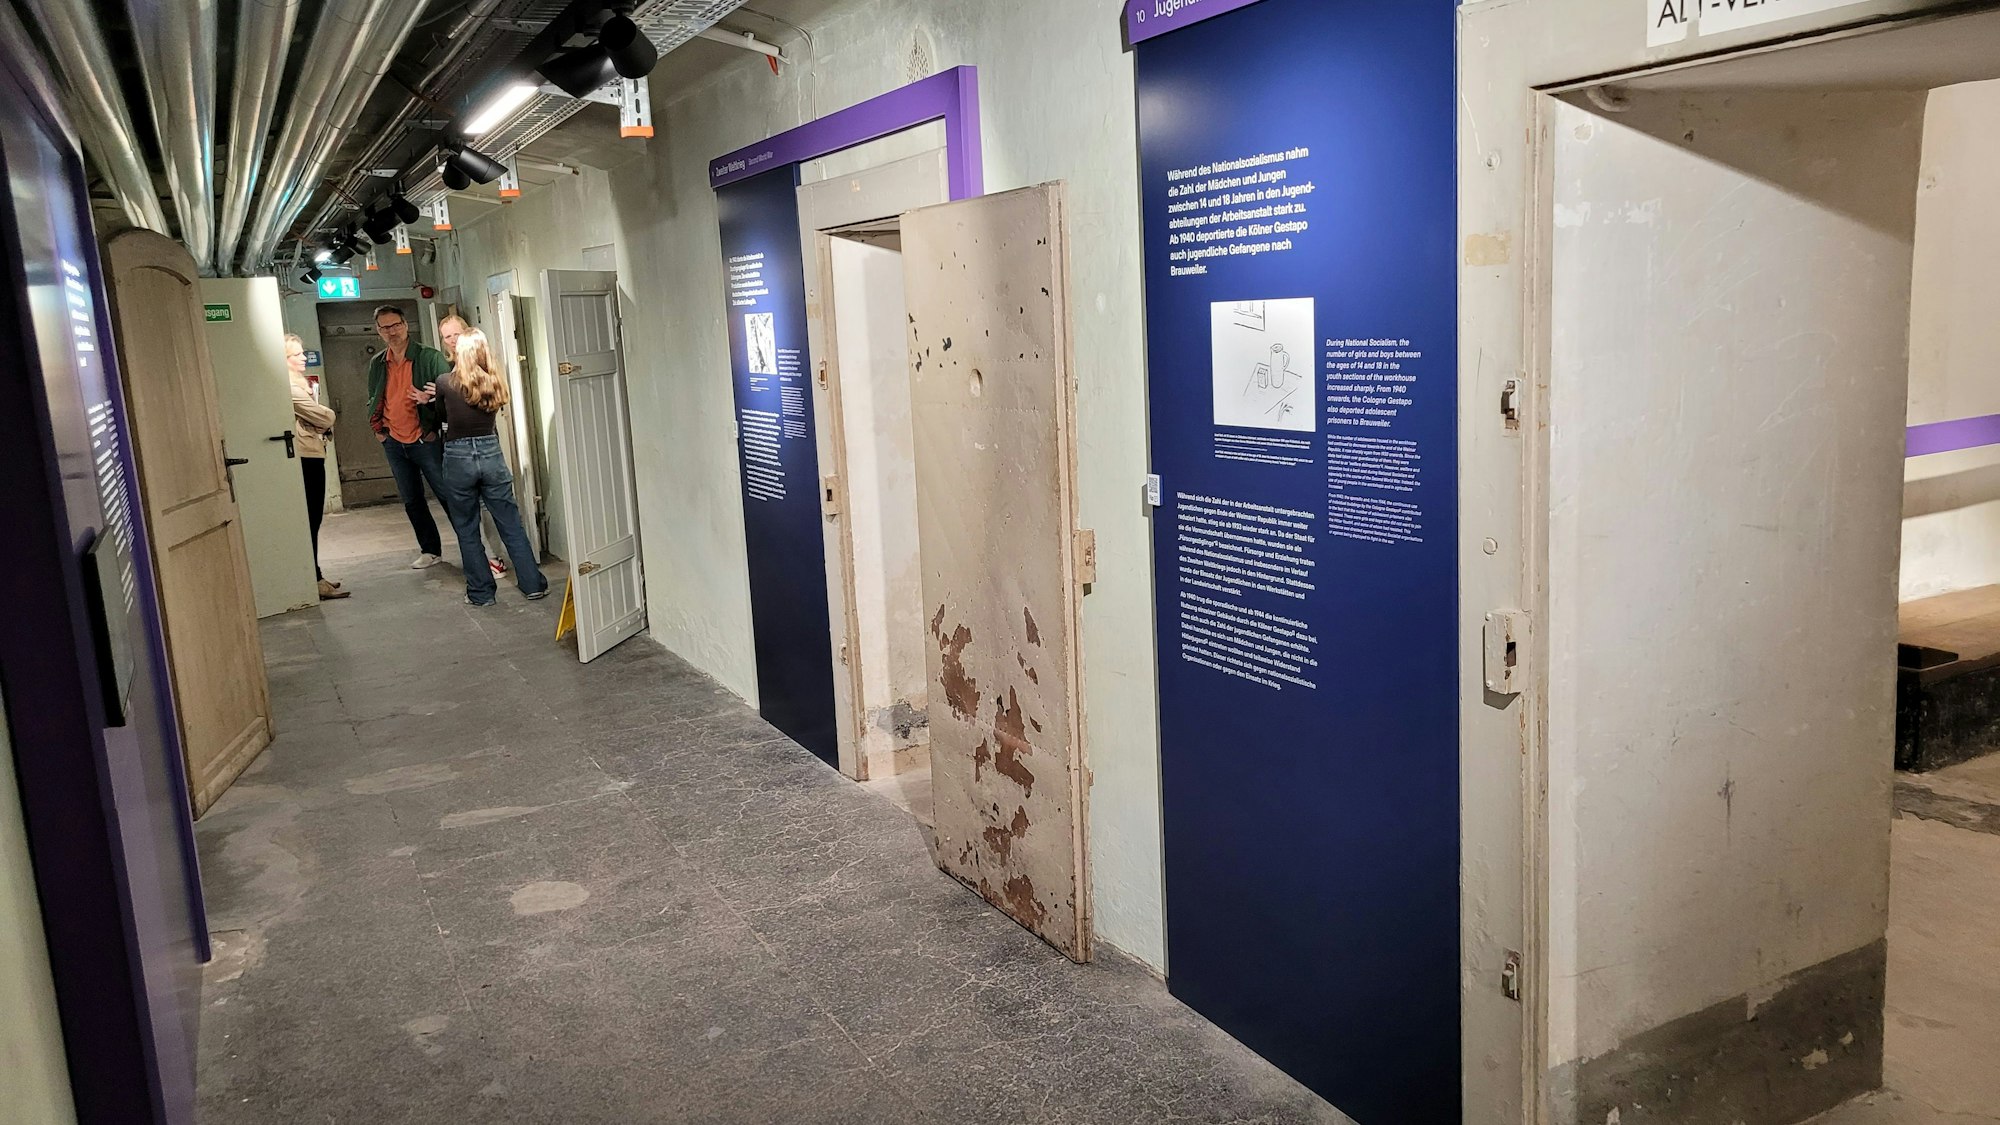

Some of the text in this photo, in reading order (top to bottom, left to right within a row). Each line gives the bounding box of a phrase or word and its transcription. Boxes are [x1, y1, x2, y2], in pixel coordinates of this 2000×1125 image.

[1136, 10, 1146, 23] 10
[1167, 147, 1308, 181] Während des Nationalsozialismus nahm
[1168, 169, 1286, 197] die Zahl der Mädchen und Jungen
[1168, 181, 1315, 213] zwischen 14 und 18 Jahren in den Jugend-
[1169, 203, 1306, 229] abteilungen der Arbeitsanstalt stark zu.
[1169, 220, 1307, 245] Ab 1940 deportierte die Kölner Gestapo
[1170, 239, 1291, 261] auch jugendliche Gefangene nach
[1171, 264, 1207, 276] Brauweiler.
[206, 309, 230, 318] sgang
[1326, 339, 1344, 348] During
[1369, 339, 1398, 347] Socialism,
[1355, 351, 1367, 359] girls
[1380, 351, 1394, 359] boys
[1354, 384, 1375, 393] sharply.
[1362, 396, 1386, 405] Cologne
[1388, 397, 1412, 406] Gestapo
[1365, 408, 1397, 416] adolescent
[1360, 419, 1390, 427] Brauweiler.
